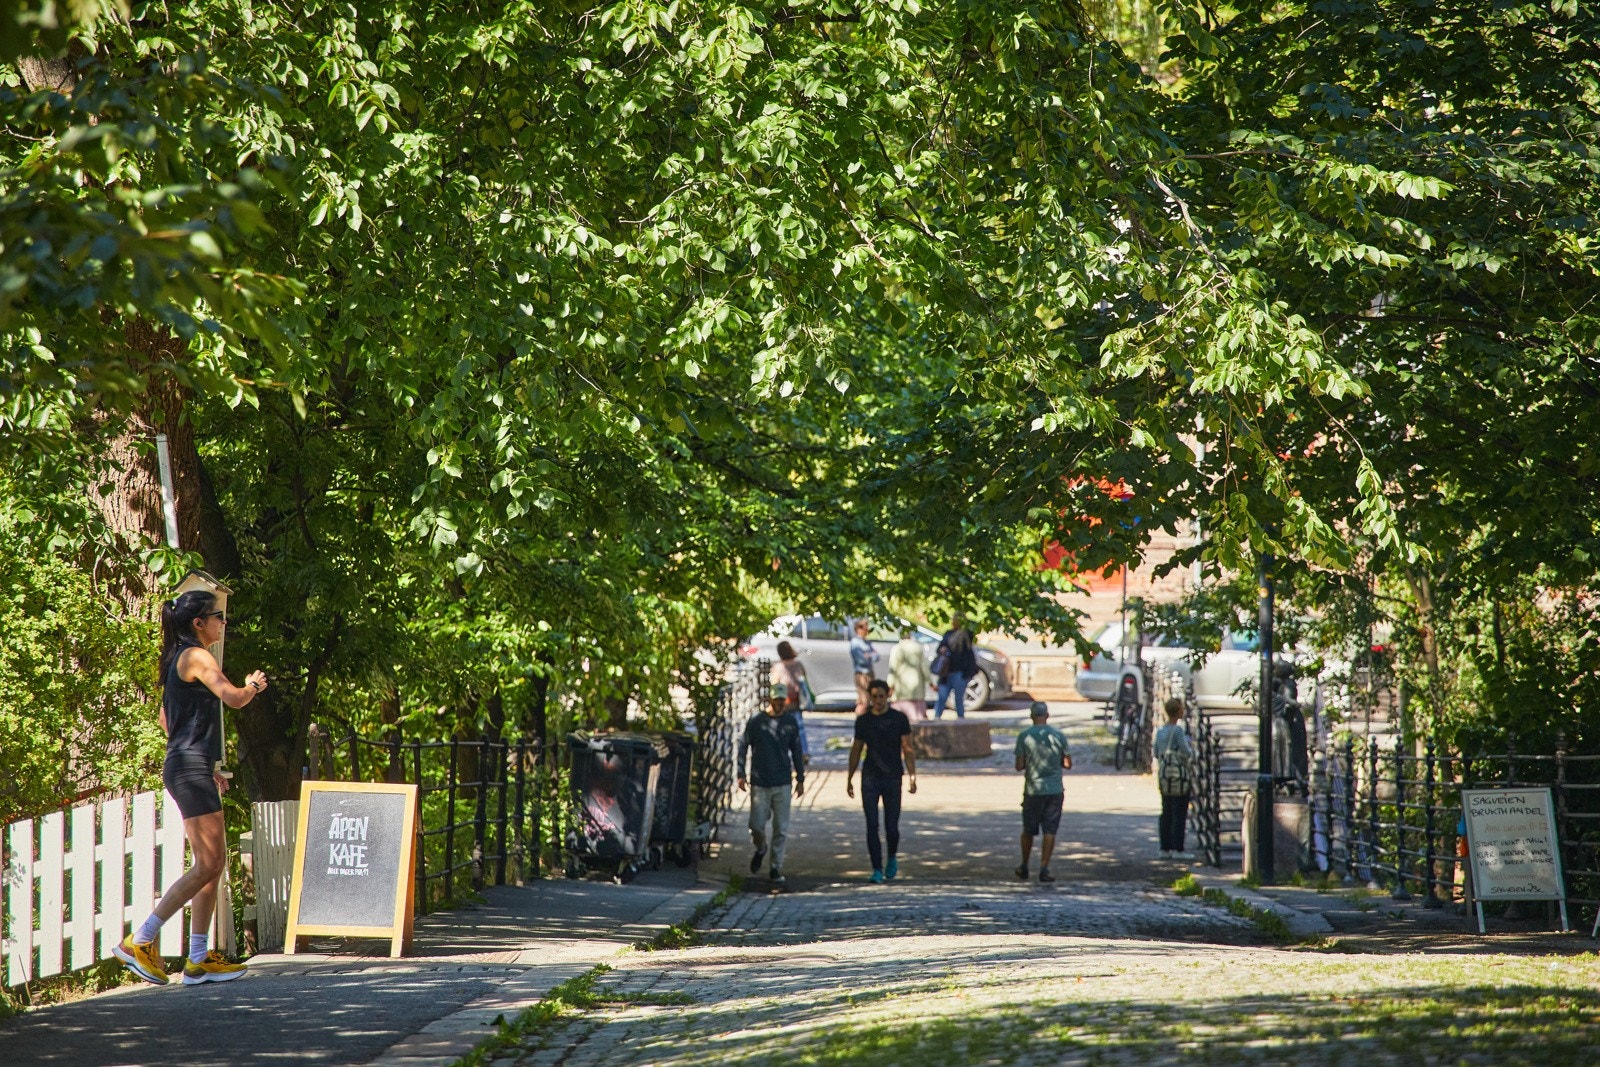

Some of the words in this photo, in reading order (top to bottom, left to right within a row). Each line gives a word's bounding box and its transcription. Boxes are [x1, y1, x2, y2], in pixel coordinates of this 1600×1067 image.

[1472, 796, 1526, 806] SAGVEIEN
[1471, 807, 1546, 817] BRUKTHANDEL
[329, 813, 369, 840] ÅPEN
[329, 843, 369, 868] KAFÉ
